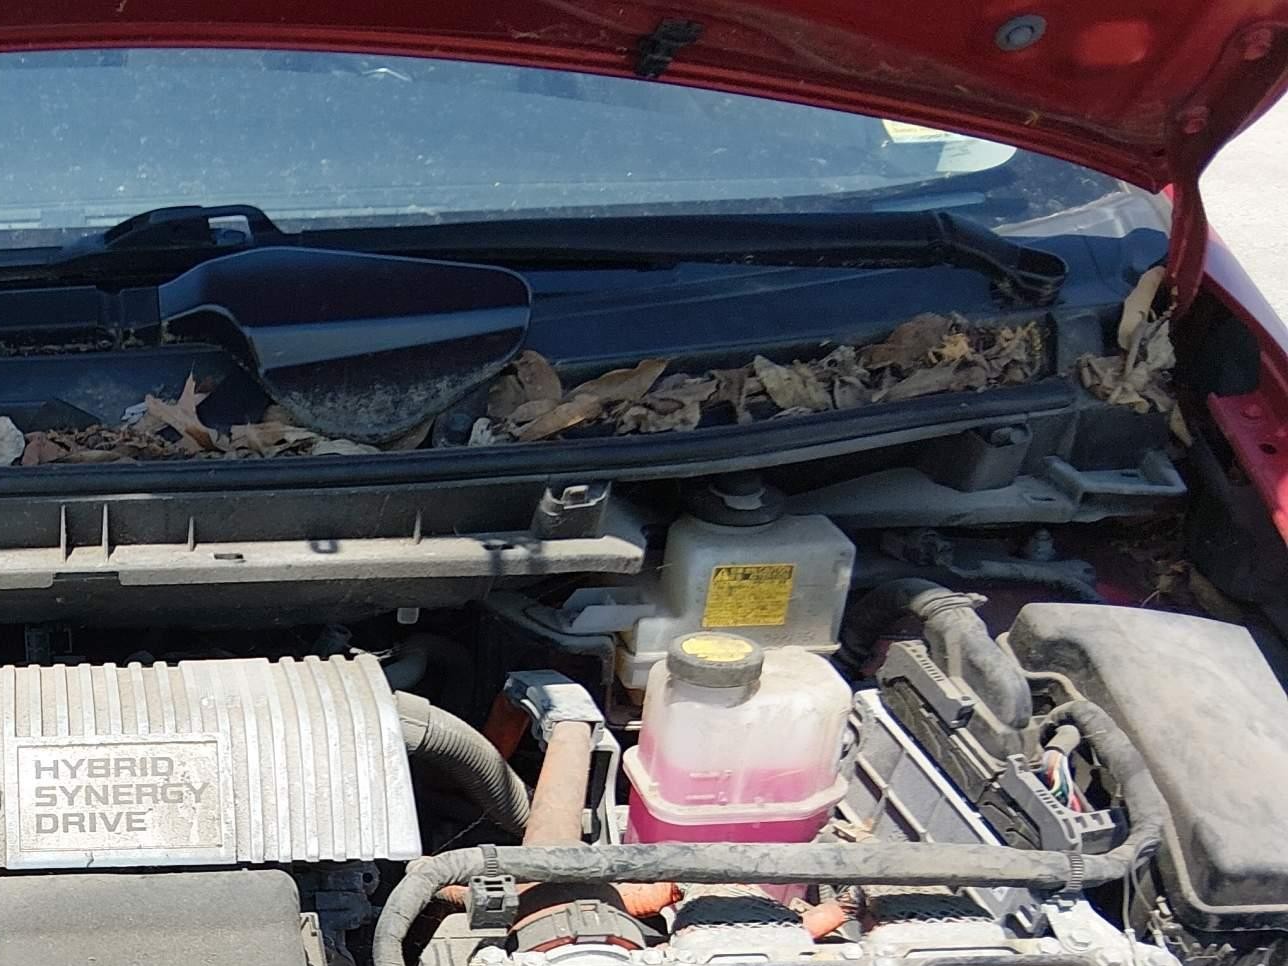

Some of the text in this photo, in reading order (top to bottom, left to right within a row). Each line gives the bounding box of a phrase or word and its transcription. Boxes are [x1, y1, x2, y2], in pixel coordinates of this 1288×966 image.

[34, 756, 174, 779] HYBRID
[34, 782, 210, 807] SYNERGY
[35, 811, 147, 834] DRIVE
